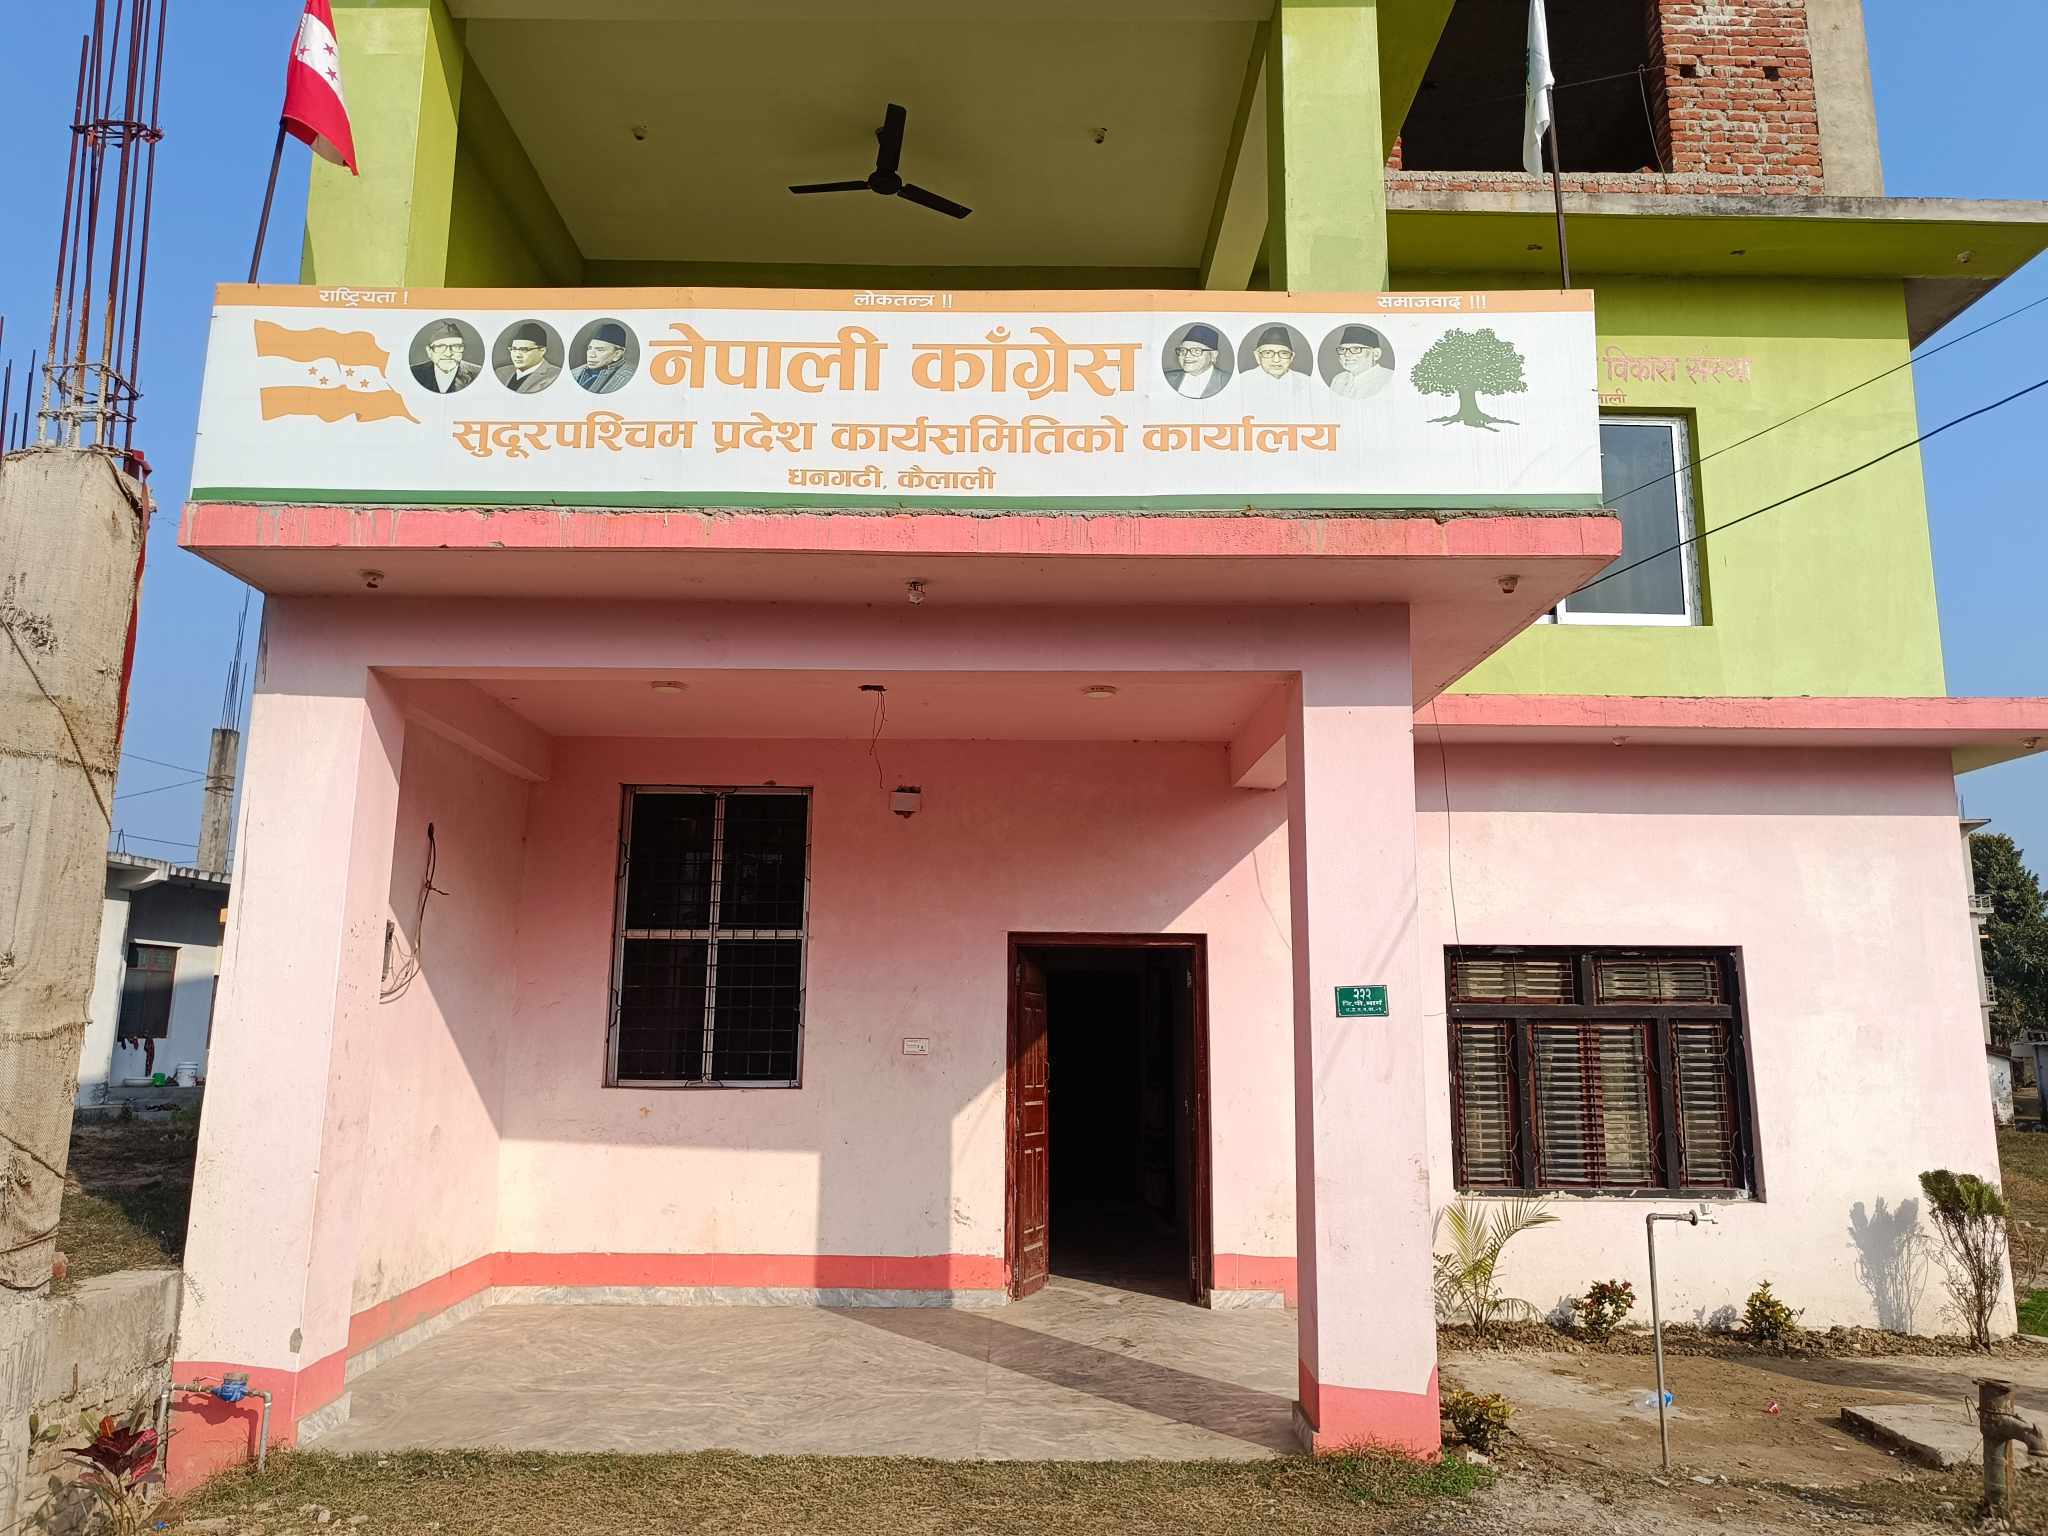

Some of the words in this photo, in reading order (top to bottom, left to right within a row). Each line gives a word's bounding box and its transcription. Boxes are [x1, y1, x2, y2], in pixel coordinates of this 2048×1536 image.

[319, 287, 397, 307] राष्ट्रियता
[853, 290, 935, 307] लोकतन्त्र
[1377, 295, 1463, 310] समाजवाद
[648, 322, 889, 394] नेपाली
[911, 326, 1143, 400] काँग्रेस
[1603, 346, 1680, 383] विकास
[1686, 346, 1753, 384] संस्था
[453, 410, 698, 458] सुदूरपश्चिम
[711, 411, 817, 453] प्रदेश
[831, 415, 1128, 455] कार्यसमितिको
[1142, 415, 1341, 453] कार्यालय
[897, 464, 996, 490] कैलाली
